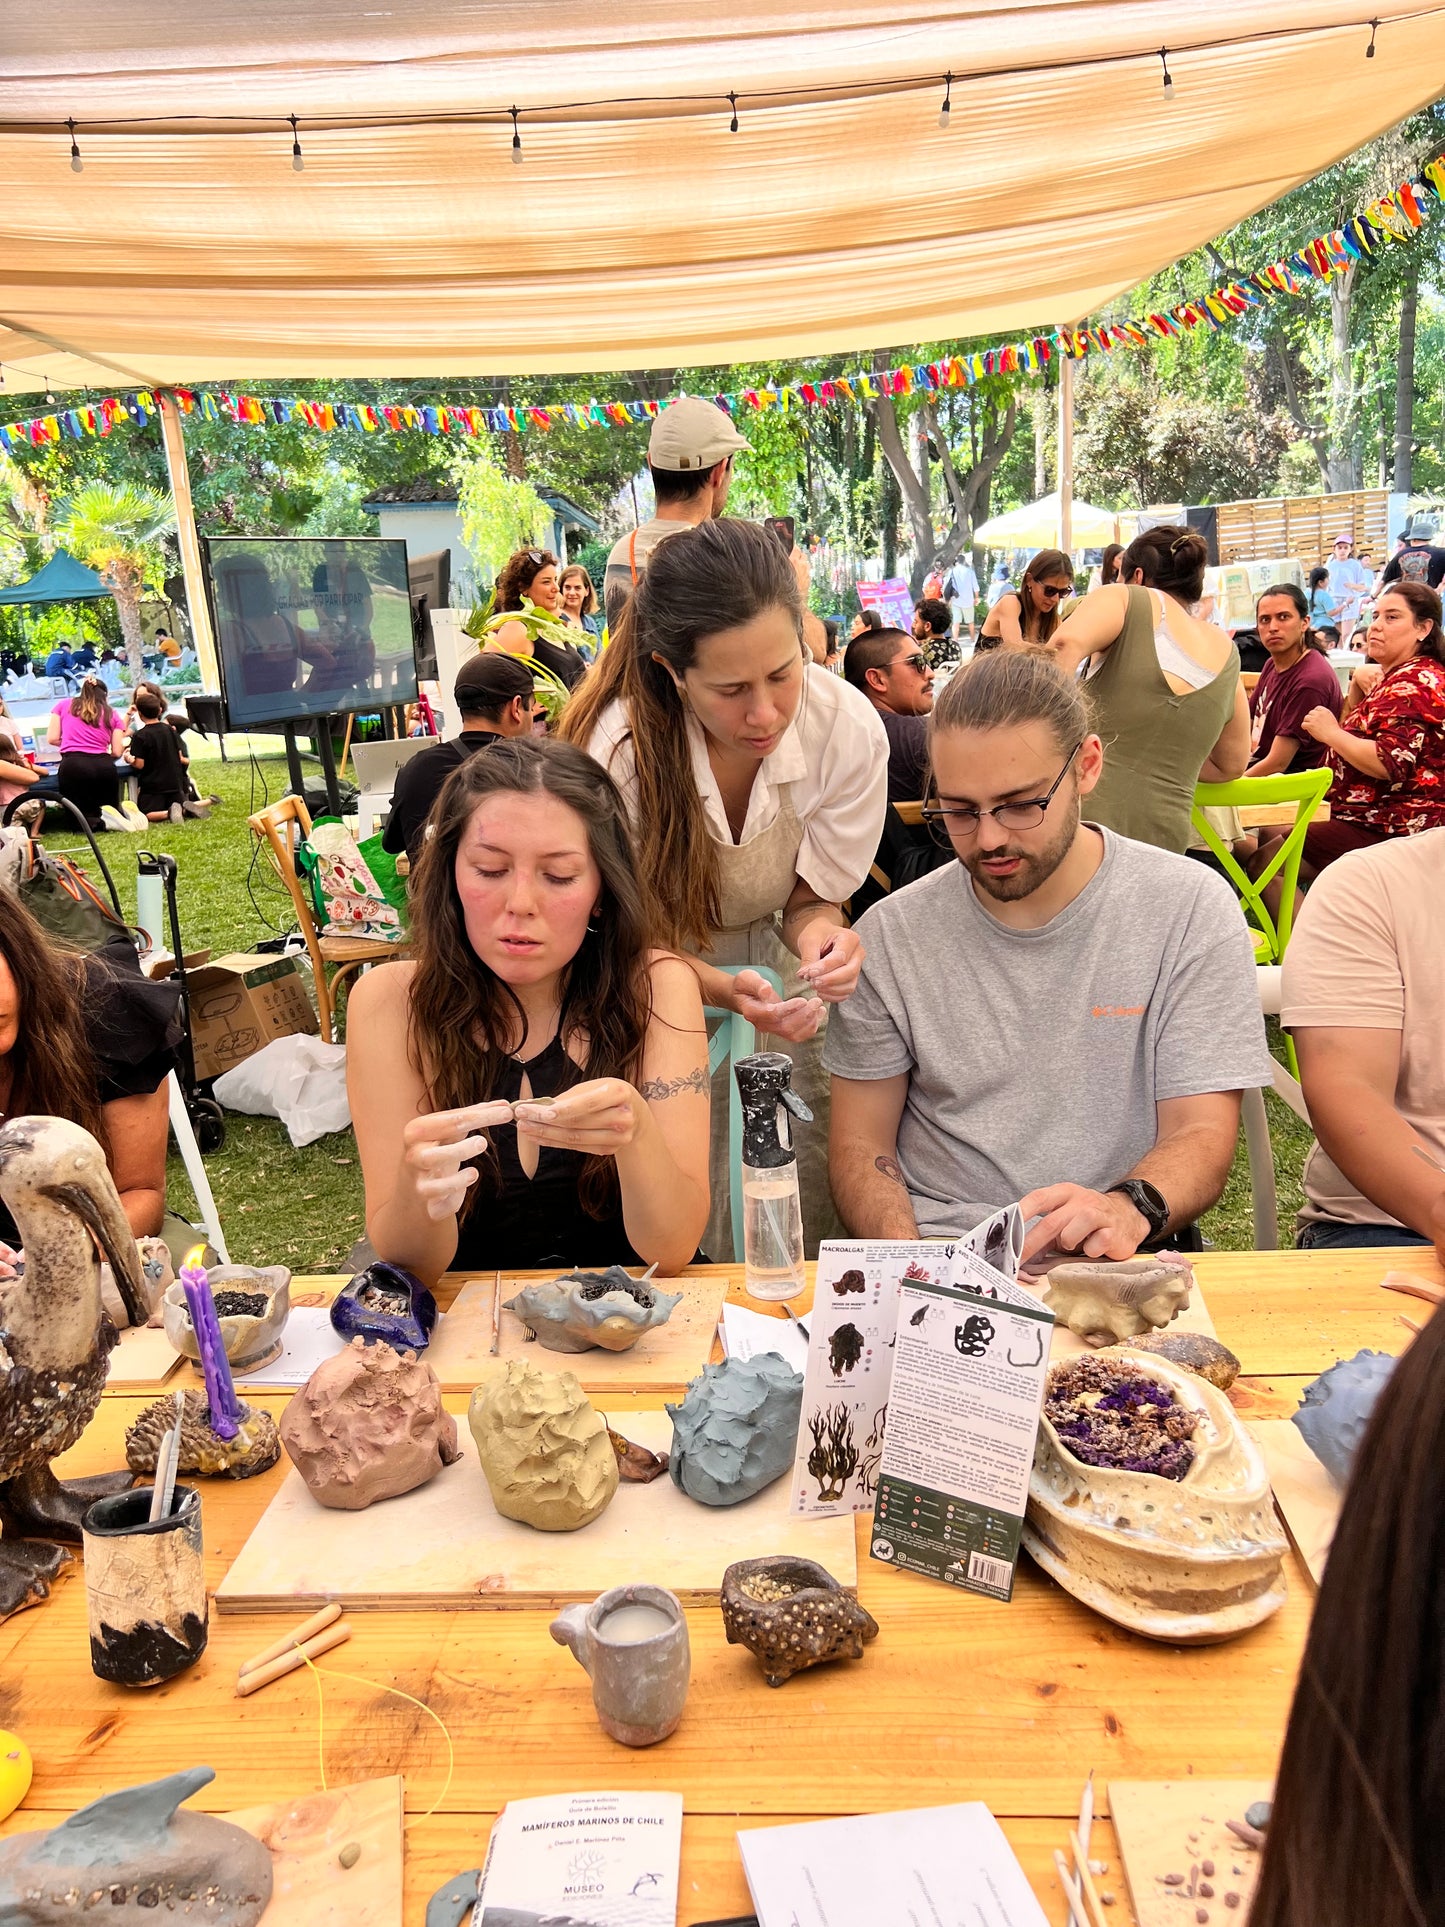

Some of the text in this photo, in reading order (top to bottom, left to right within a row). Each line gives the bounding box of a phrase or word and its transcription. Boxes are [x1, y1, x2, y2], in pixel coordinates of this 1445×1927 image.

[522, 1817, 665, 1832] MAMÍFEROS MARINOS DE CHILE
[564, 1884, 605, 1894] MUSEO
